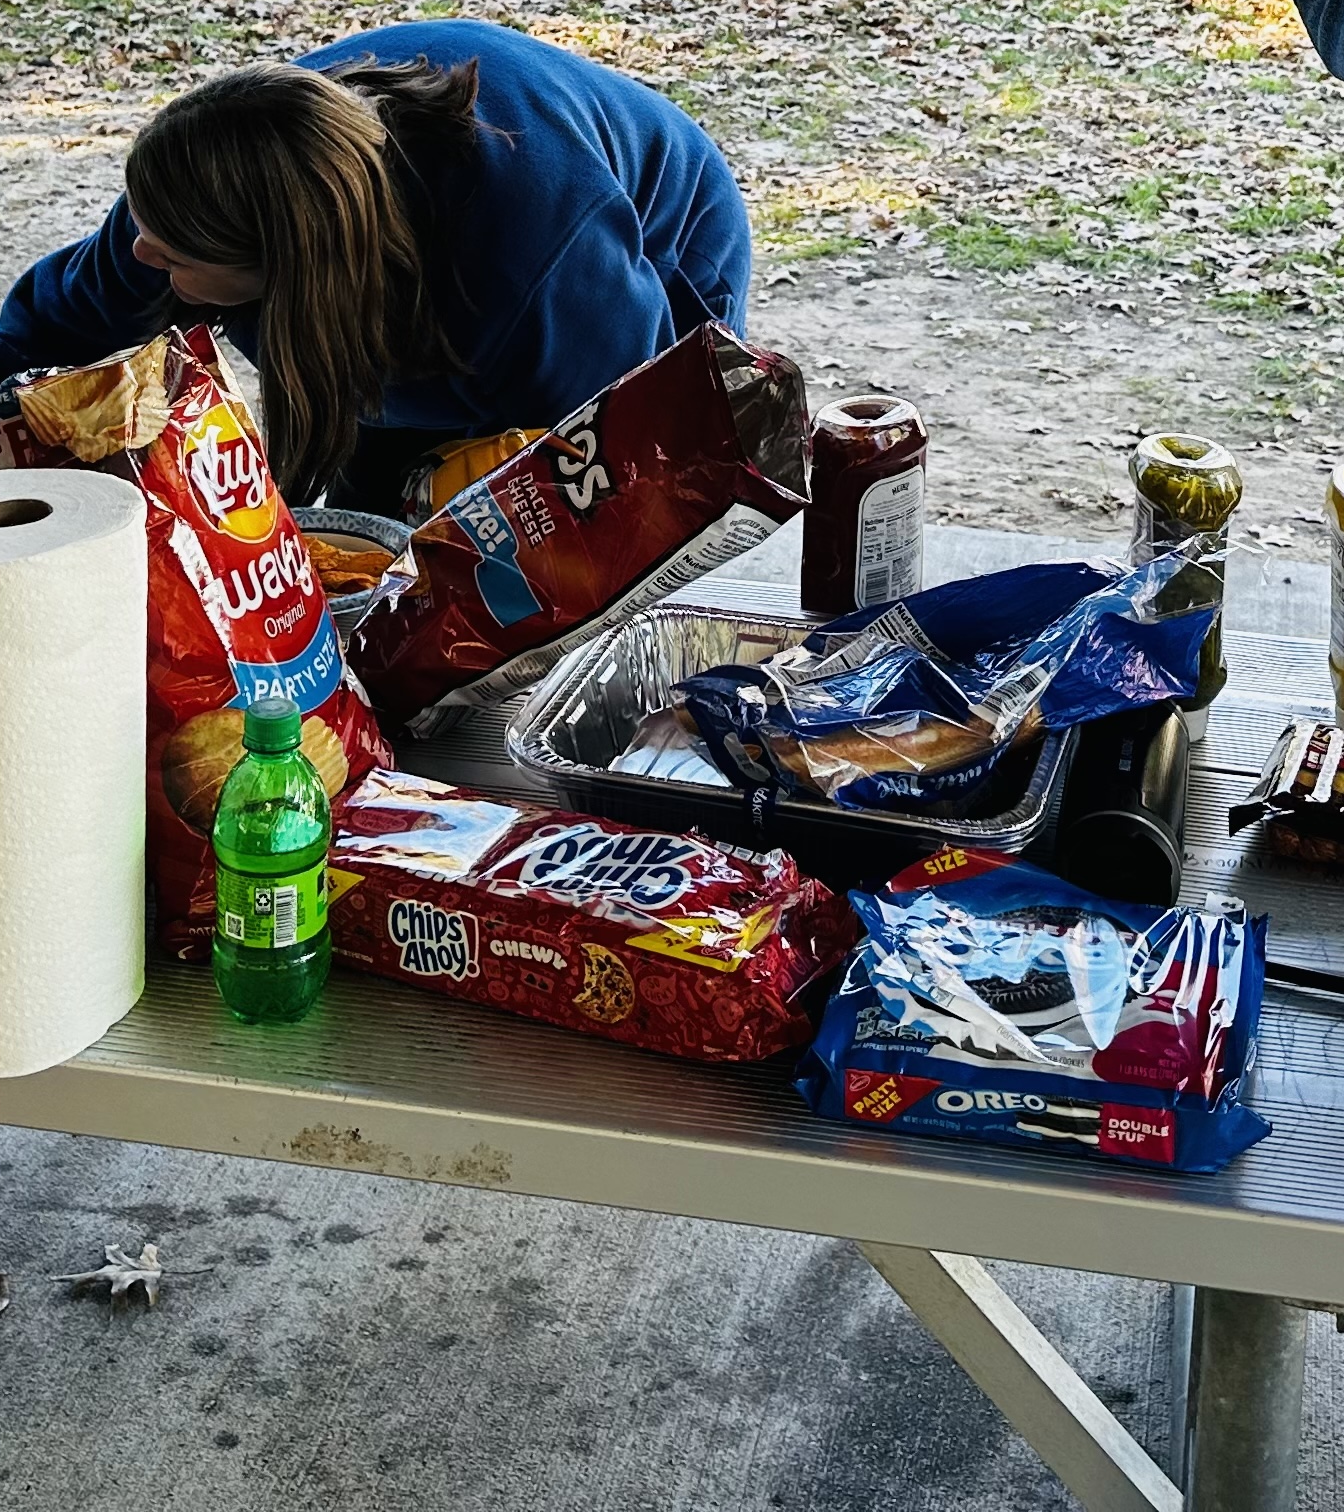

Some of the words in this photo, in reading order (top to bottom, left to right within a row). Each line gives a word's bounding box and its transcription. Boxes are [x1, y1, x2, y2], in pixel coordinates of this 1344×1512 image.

[506, 474, 544, 548] CHEESE
[214, 531, 315, 621] wavy
[264, 600, 307, 639] Original
[253, 664, 318, 703] PARTY
[312, 630, 337, 680] SIZE
[923, 850, 969, 876] SIZE
[391, 901, 463, 945] Chips
[489, 939, 569, 971] CHEWY
[852, 1076, 898, 1115] PARTY
[870, 1090, 903, 1119] SIZE
[936, 1089, 1046, 1113] OREO
[1107, 1117, 1170, 1138] DOUBLE
[1107, 1129, 1147, 1144] STUF
